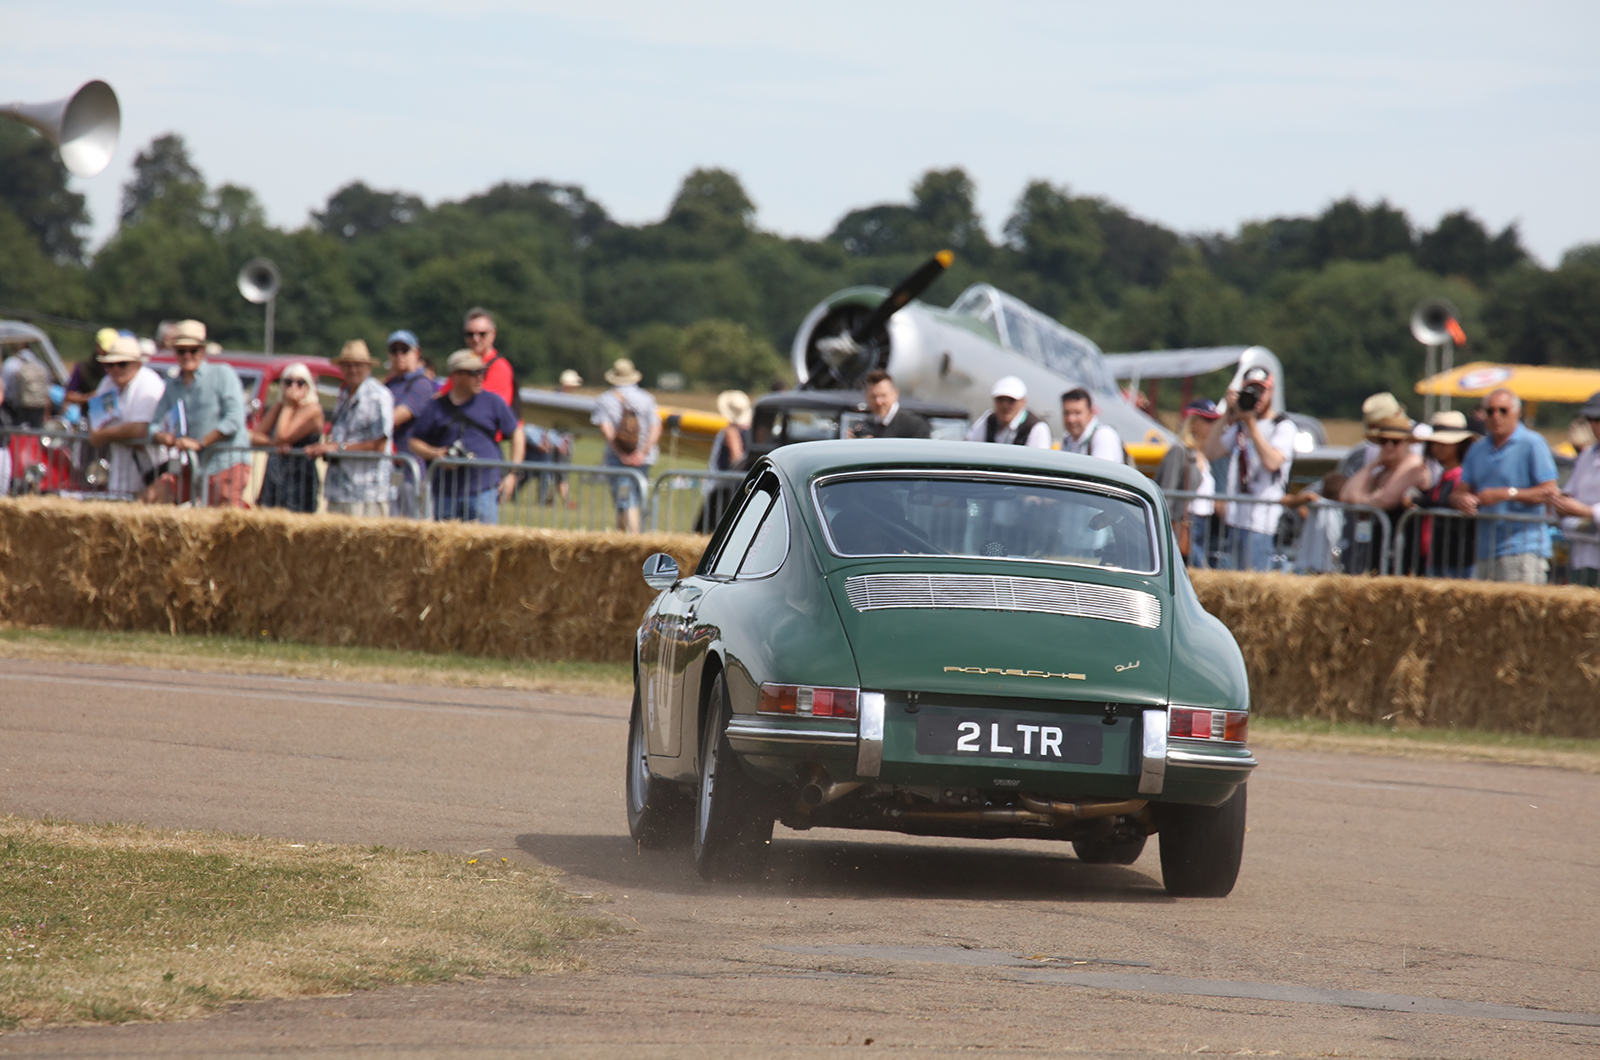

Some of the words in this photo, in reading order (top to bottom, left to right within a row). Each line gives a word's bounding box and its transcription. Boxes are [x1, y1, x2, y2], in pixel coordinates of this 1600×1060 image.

[943, 666, 1087, 681] PORSCHE
[957, 721, 981, 752] 2
[990, 723, 1063, 757] LTR
